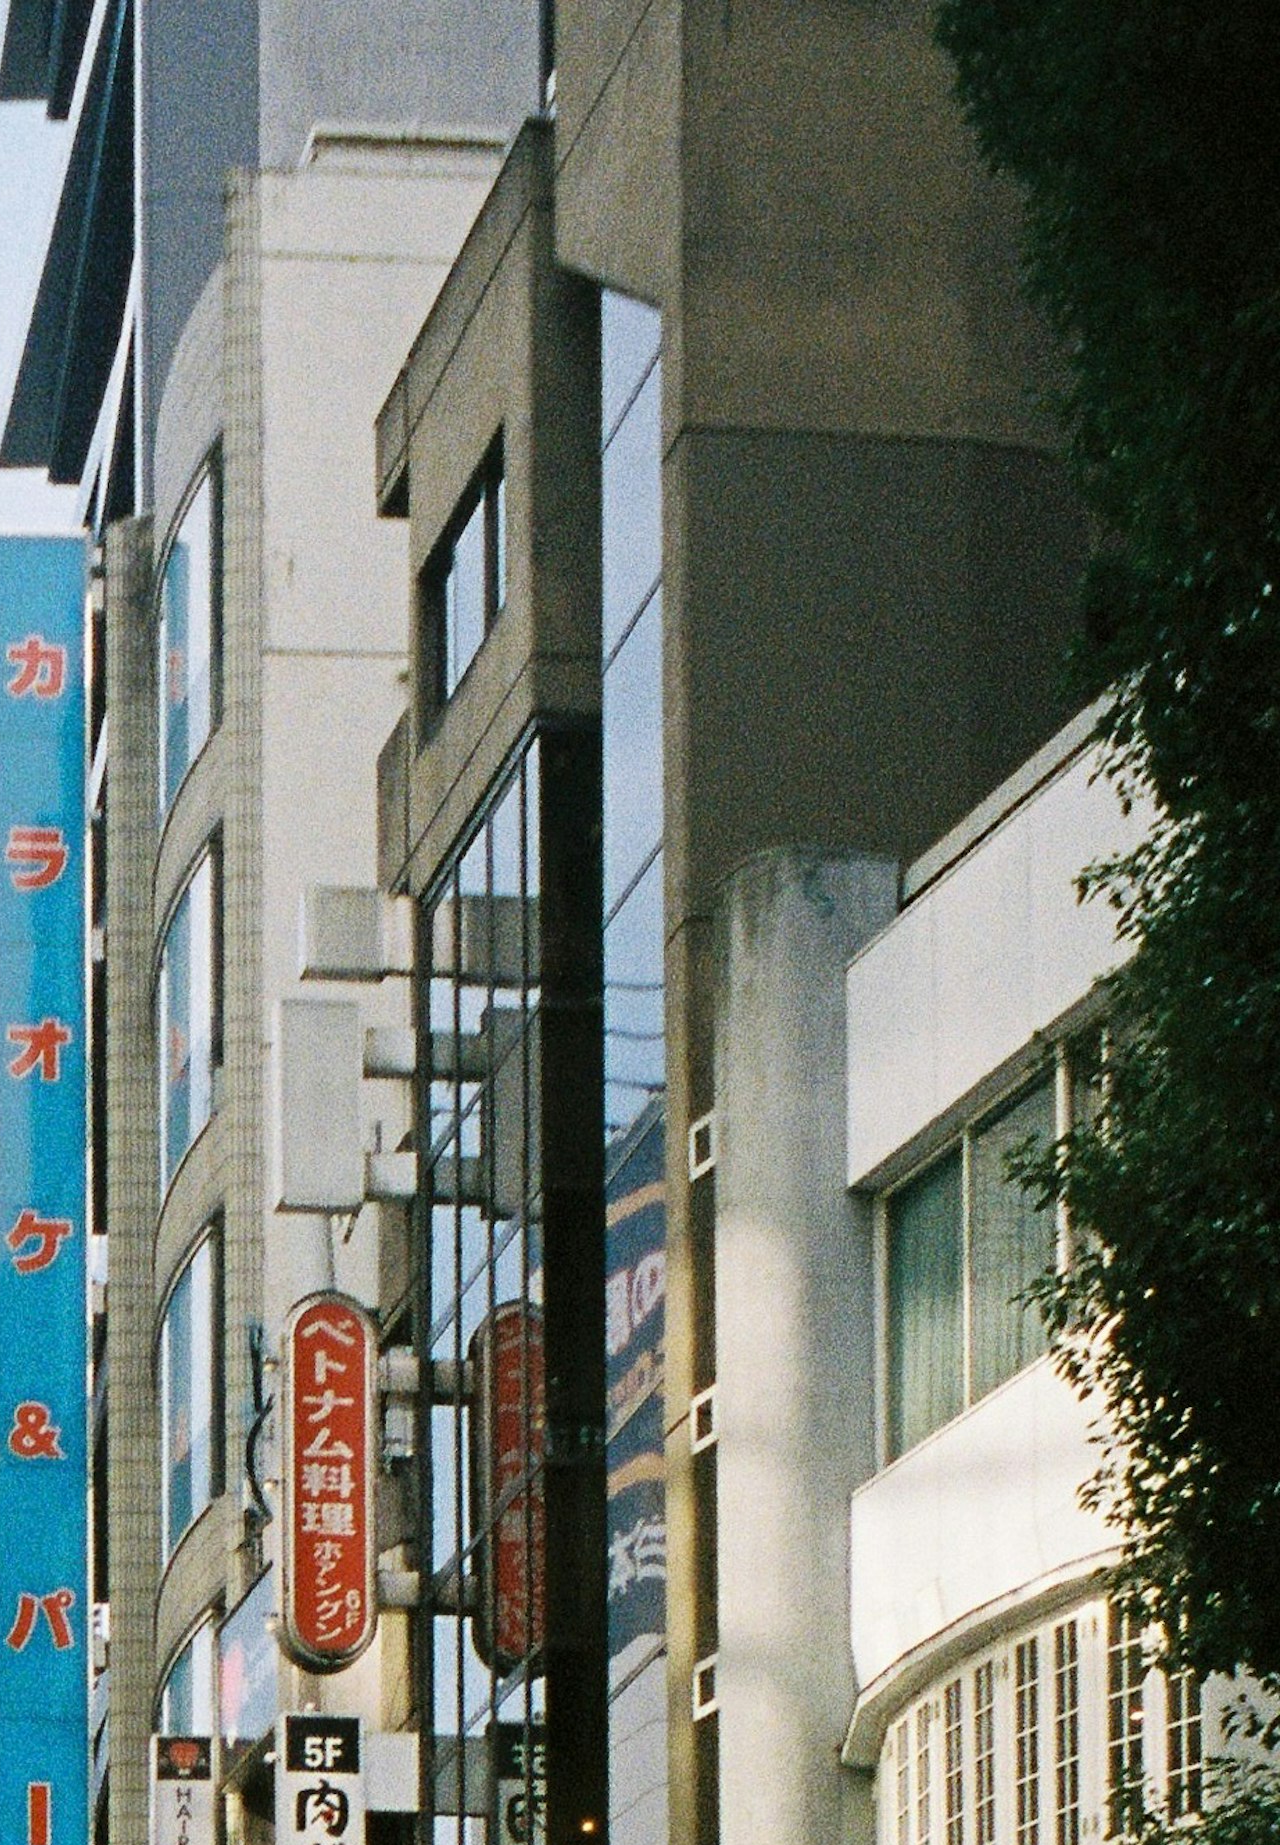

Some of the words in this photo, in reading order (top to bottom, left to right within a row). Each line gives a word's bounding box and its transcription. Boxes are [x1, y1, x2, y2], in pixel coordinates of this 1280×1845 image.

[301, 1318, 356, 1538] ベトナム料理
[303, 1736, 343, 1768] 5F
